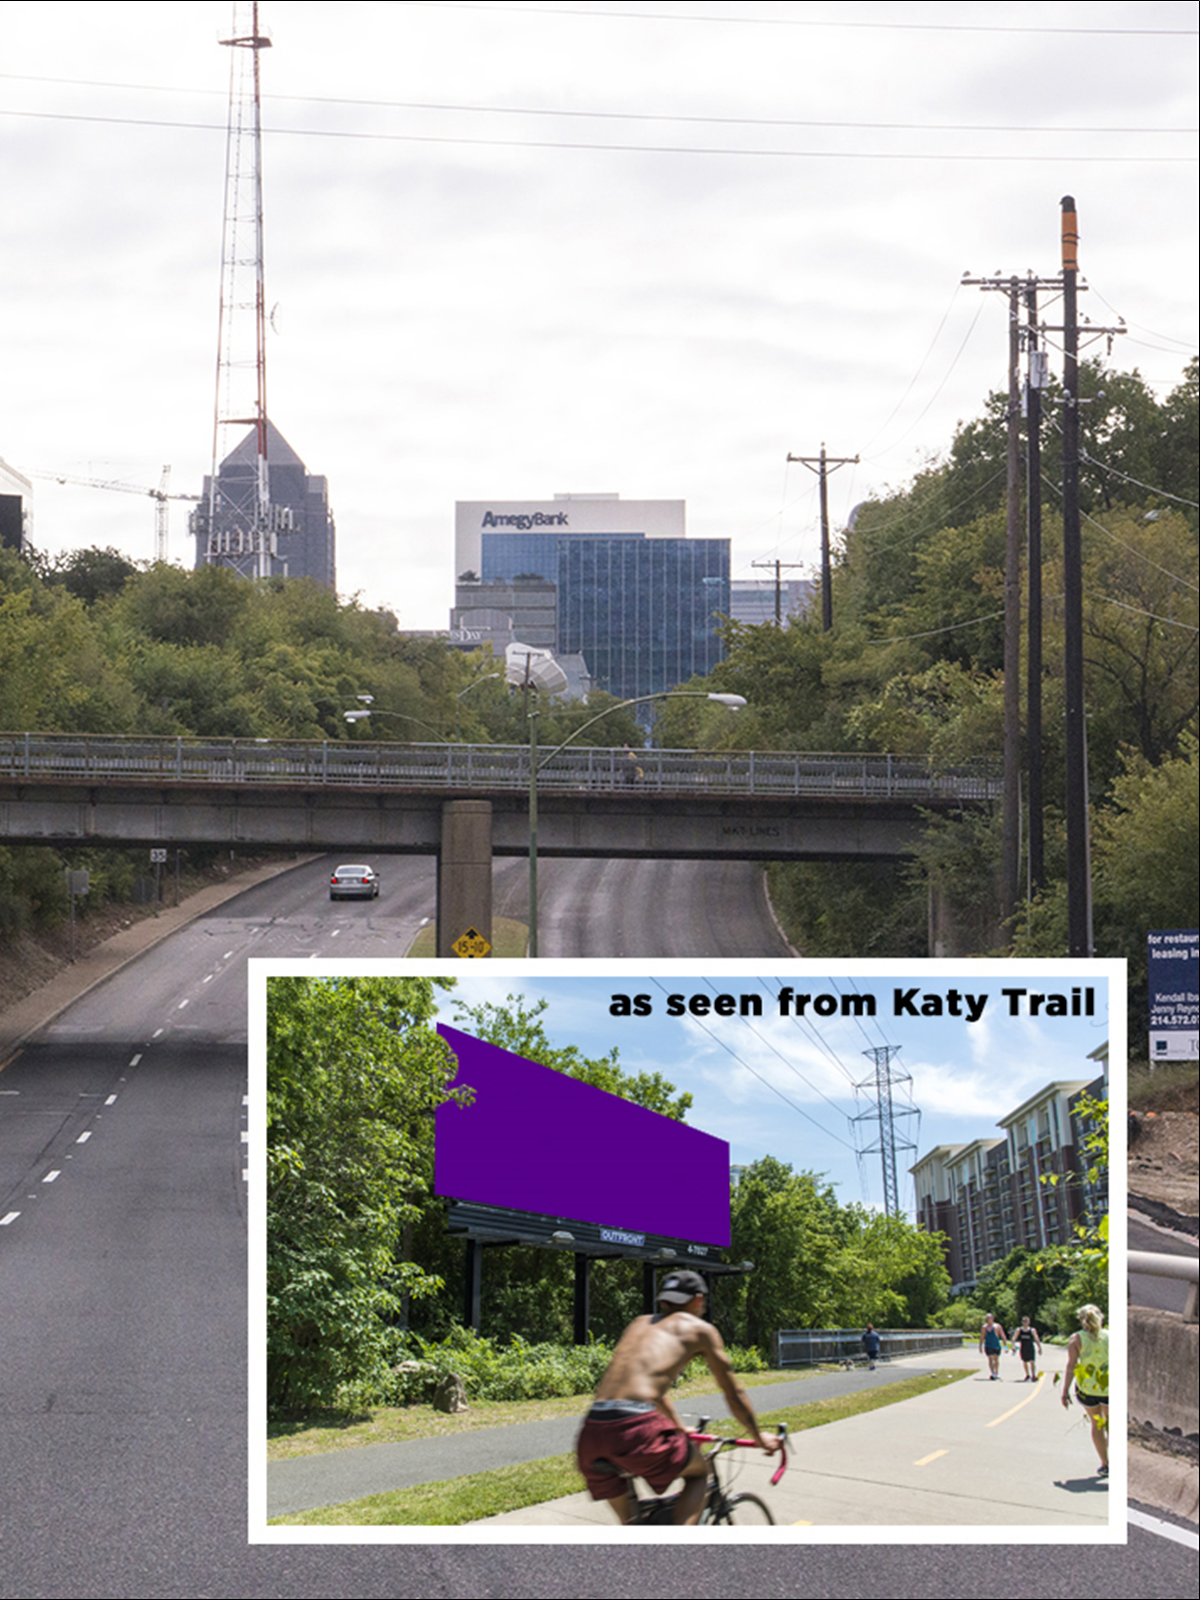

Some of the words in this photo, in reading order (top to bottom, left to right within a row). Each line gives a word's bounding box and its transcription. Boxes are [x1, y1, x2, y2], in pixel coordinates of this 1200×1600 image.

[481, 511, 569, 530] AmegyBank
[1148, 934, 1162, 944] for
[1152, 948, 1188, 960] leasing
